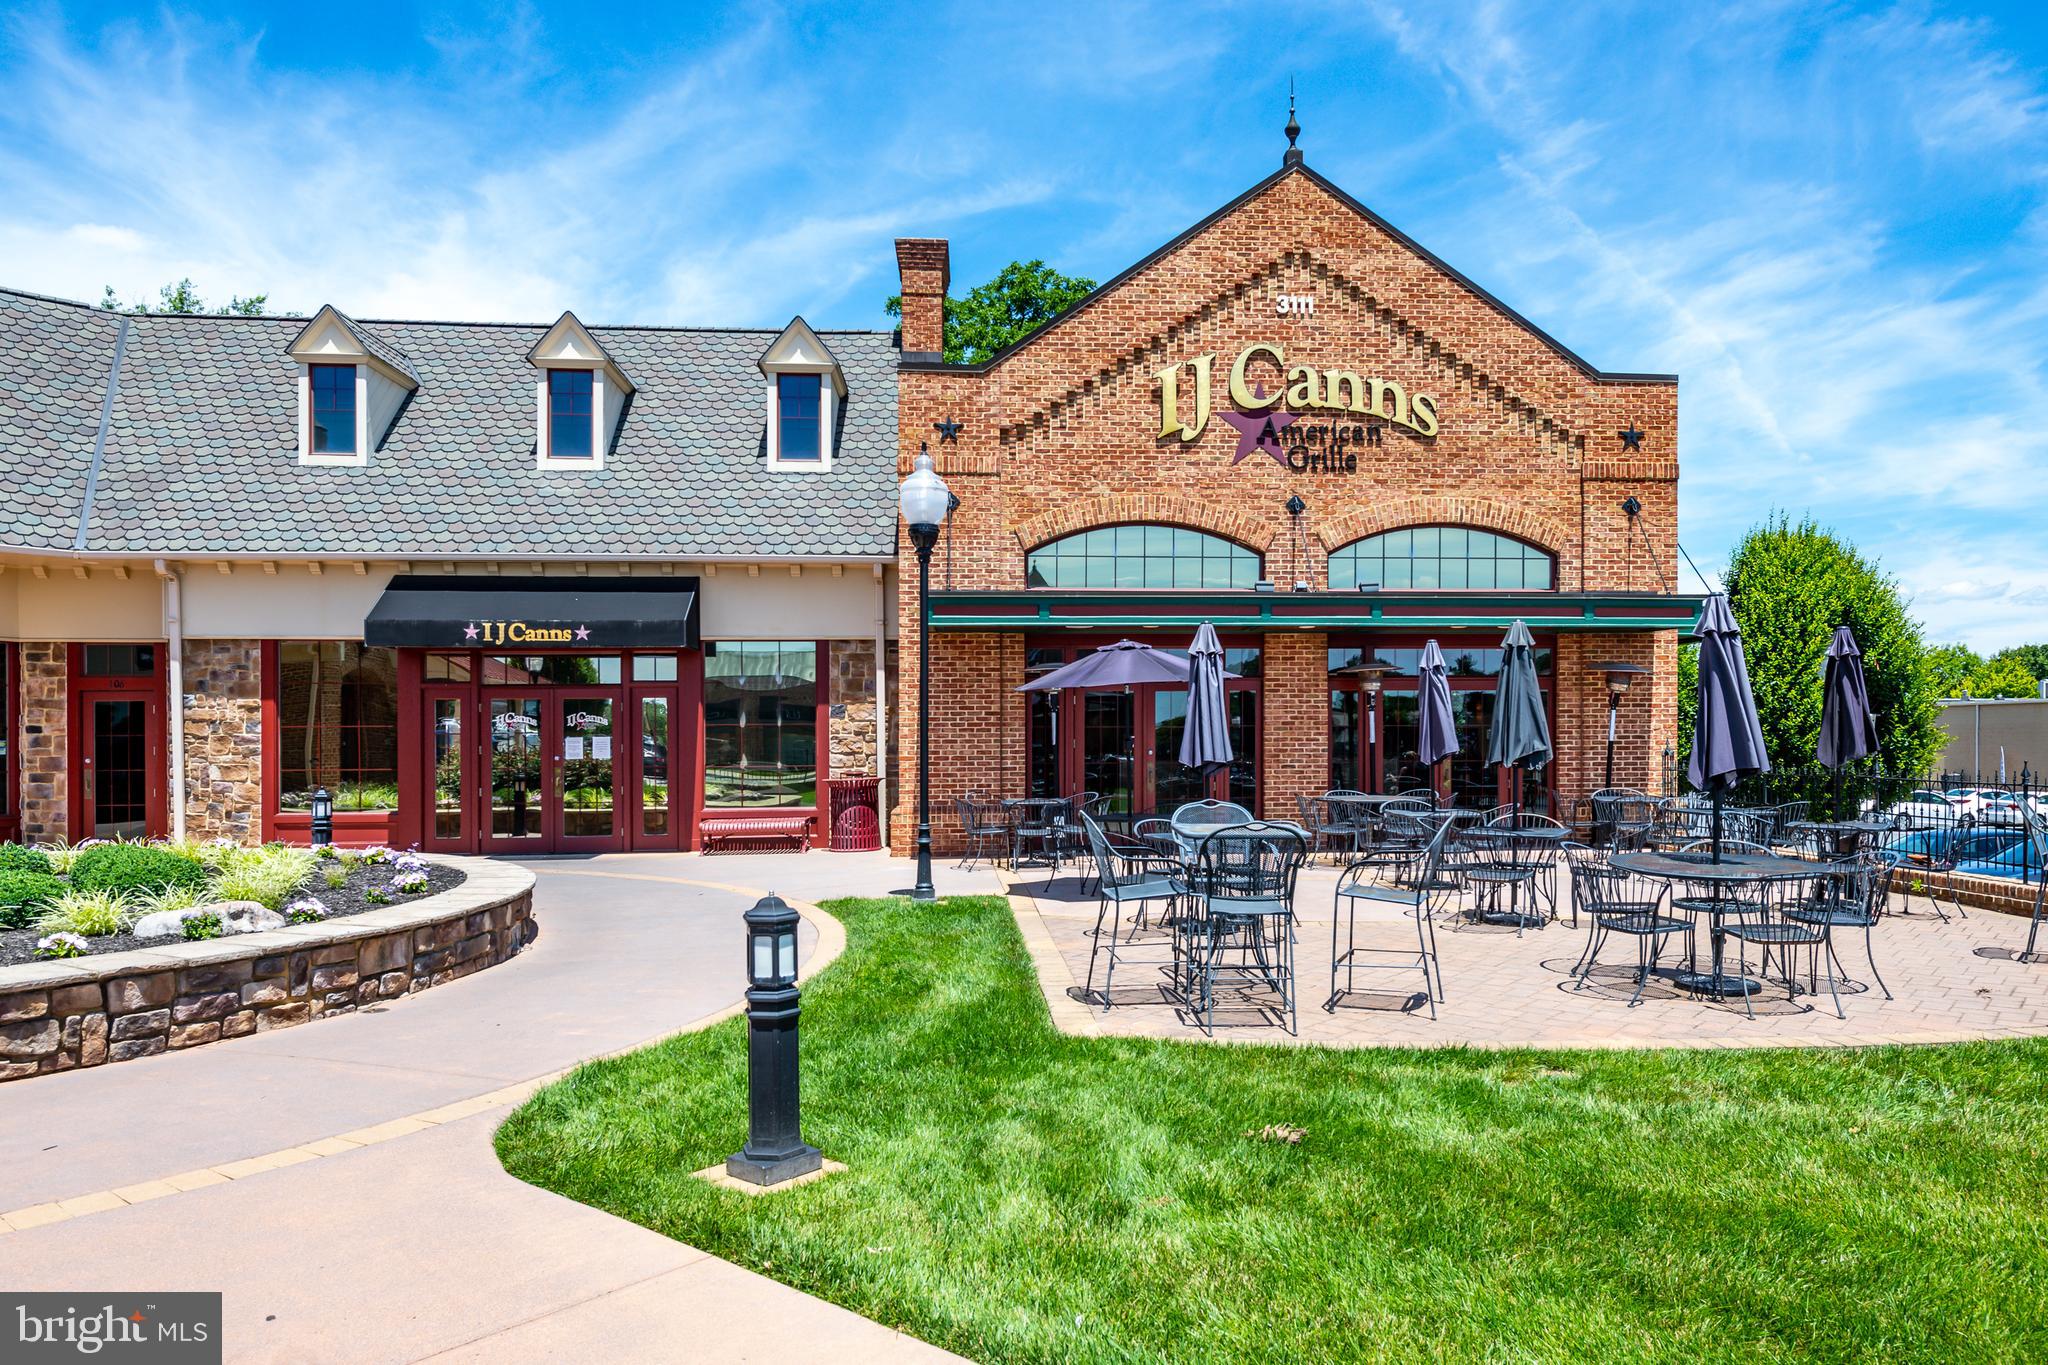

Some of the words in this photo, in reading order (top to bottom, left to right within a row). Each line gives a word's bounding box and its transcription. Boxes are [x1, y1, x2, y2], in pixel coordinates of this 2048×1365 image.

[1276, 295, 1314, 314] 3111
[1152, 351, 1217, 442] IJ
[1228, 343, 1439, 437] Canns
[1256, 416, 1381, 443] American
[1287, 445, 1357, 471] Grille
[507, 622, 573, 642] Canns
[505, 712, 538, 727] Canns
[576, 711, 609, 726] Canns
